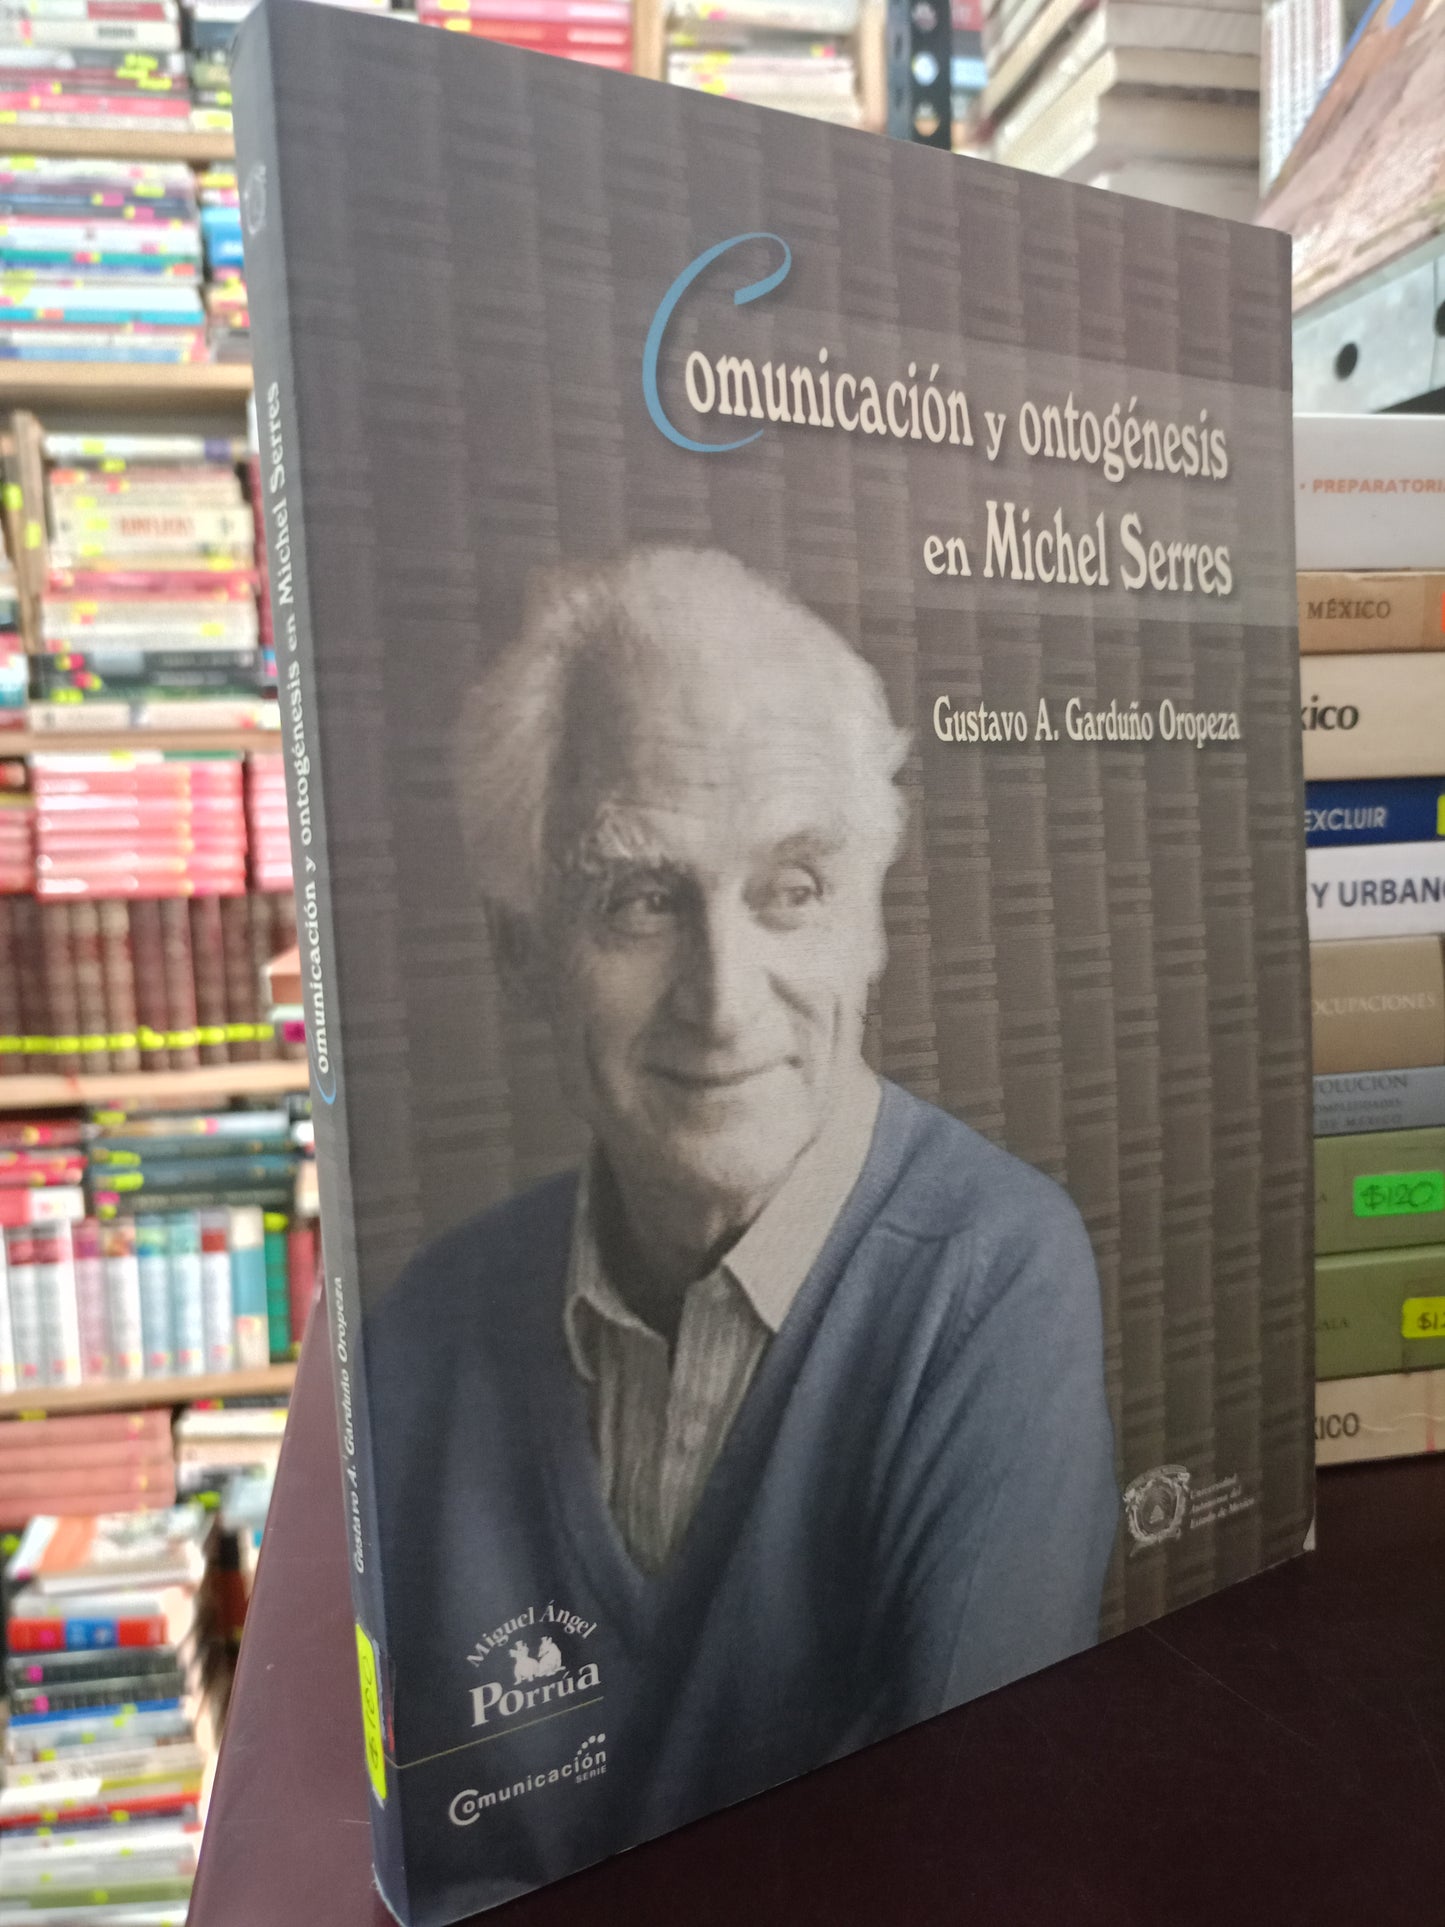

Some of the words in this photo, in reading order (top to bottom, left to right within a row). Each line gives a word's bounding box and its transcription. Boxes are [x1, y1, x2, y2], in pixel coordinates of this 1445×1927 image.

[642, 231, 974, 452] Comunicación
[984, 409, 1006, 461] y
[1018, 391, 1229, 483] ontogénesis
[267, 381, 286, 494] Serres
[1312, 478, 1445, 494] PREPARATORI
[272, 497, 294, 606] Michel
[923, 532, 972, 577] en
[983, 500, 1109, 586] Michel
[1119, 512, 1233, 596] Serres
[285, 613, 298, 652] en
[1307, 598, 1391, 620] MÉXICO
[286, 660, 312, 846] ontogénesis
[933, 695, 1028, 743] Gustavo
[1034, 698, 1059, 742] A.
[1065, 697, 1154, 742] Garduño
[1159, 698, 1241, 749] Oropeza
[305, 855, 317, 872] y
[1311, 882, 1329, 909] Y
[1338, 877, 1445, 908] URBAN
[333, 1276, 349, 1363] Oropeza
[340, 1369, 356, 1456] Garduño
[348, 1490, 365, 1574] Gustavo
[466, 1605, 535, 1669] Miguel
[538, 1600, 598, 1640] Ángel
[468, 1662, 602, 1728] Porrúa
[449, 1738, 607, 1826] Comunicación
[574, 1763, 608, 1785] SERIE
